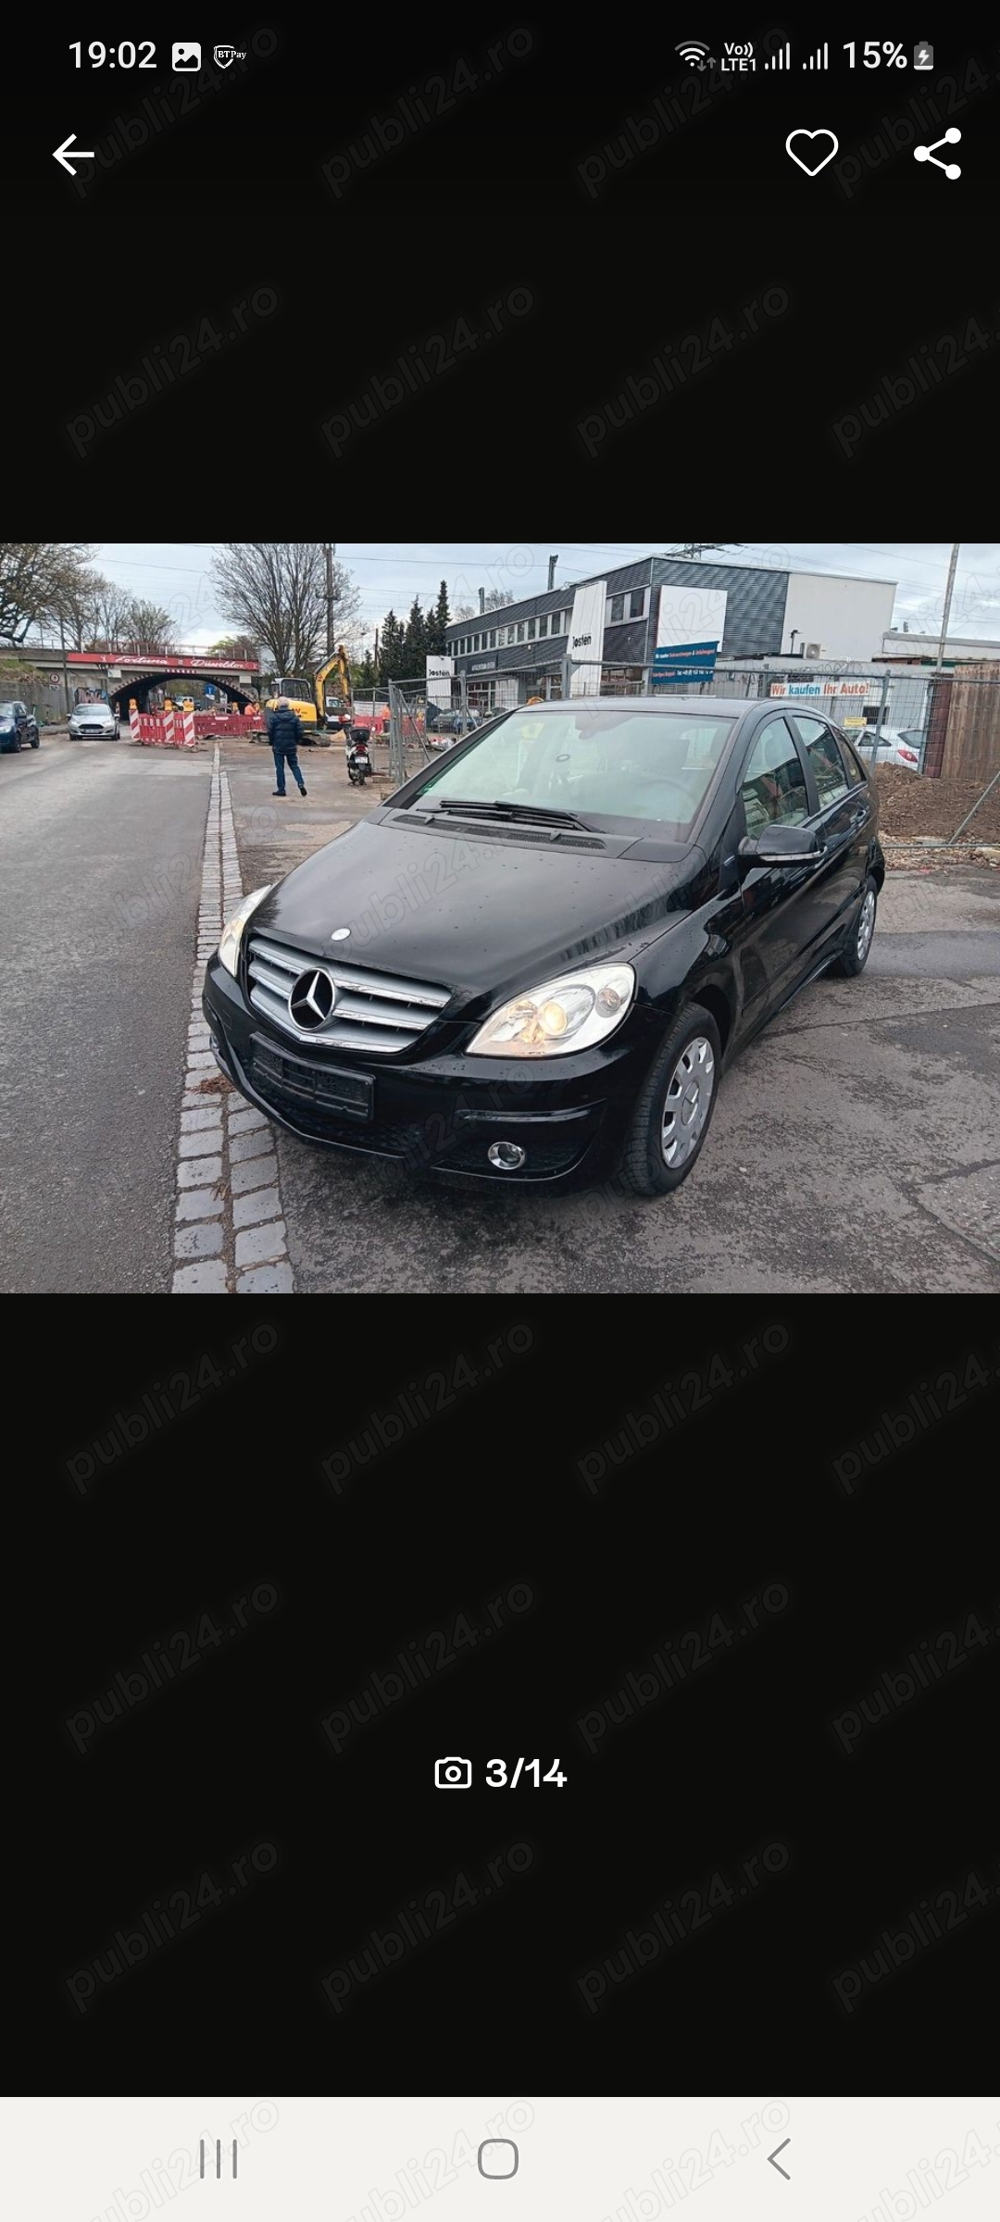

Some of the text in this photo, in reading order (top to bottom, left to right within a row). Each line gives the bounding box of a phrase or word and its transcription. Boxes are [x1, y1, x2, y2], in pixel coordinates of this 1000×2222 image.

[772, 682, 869, 695] Wir kaufen Ihr Auto!
